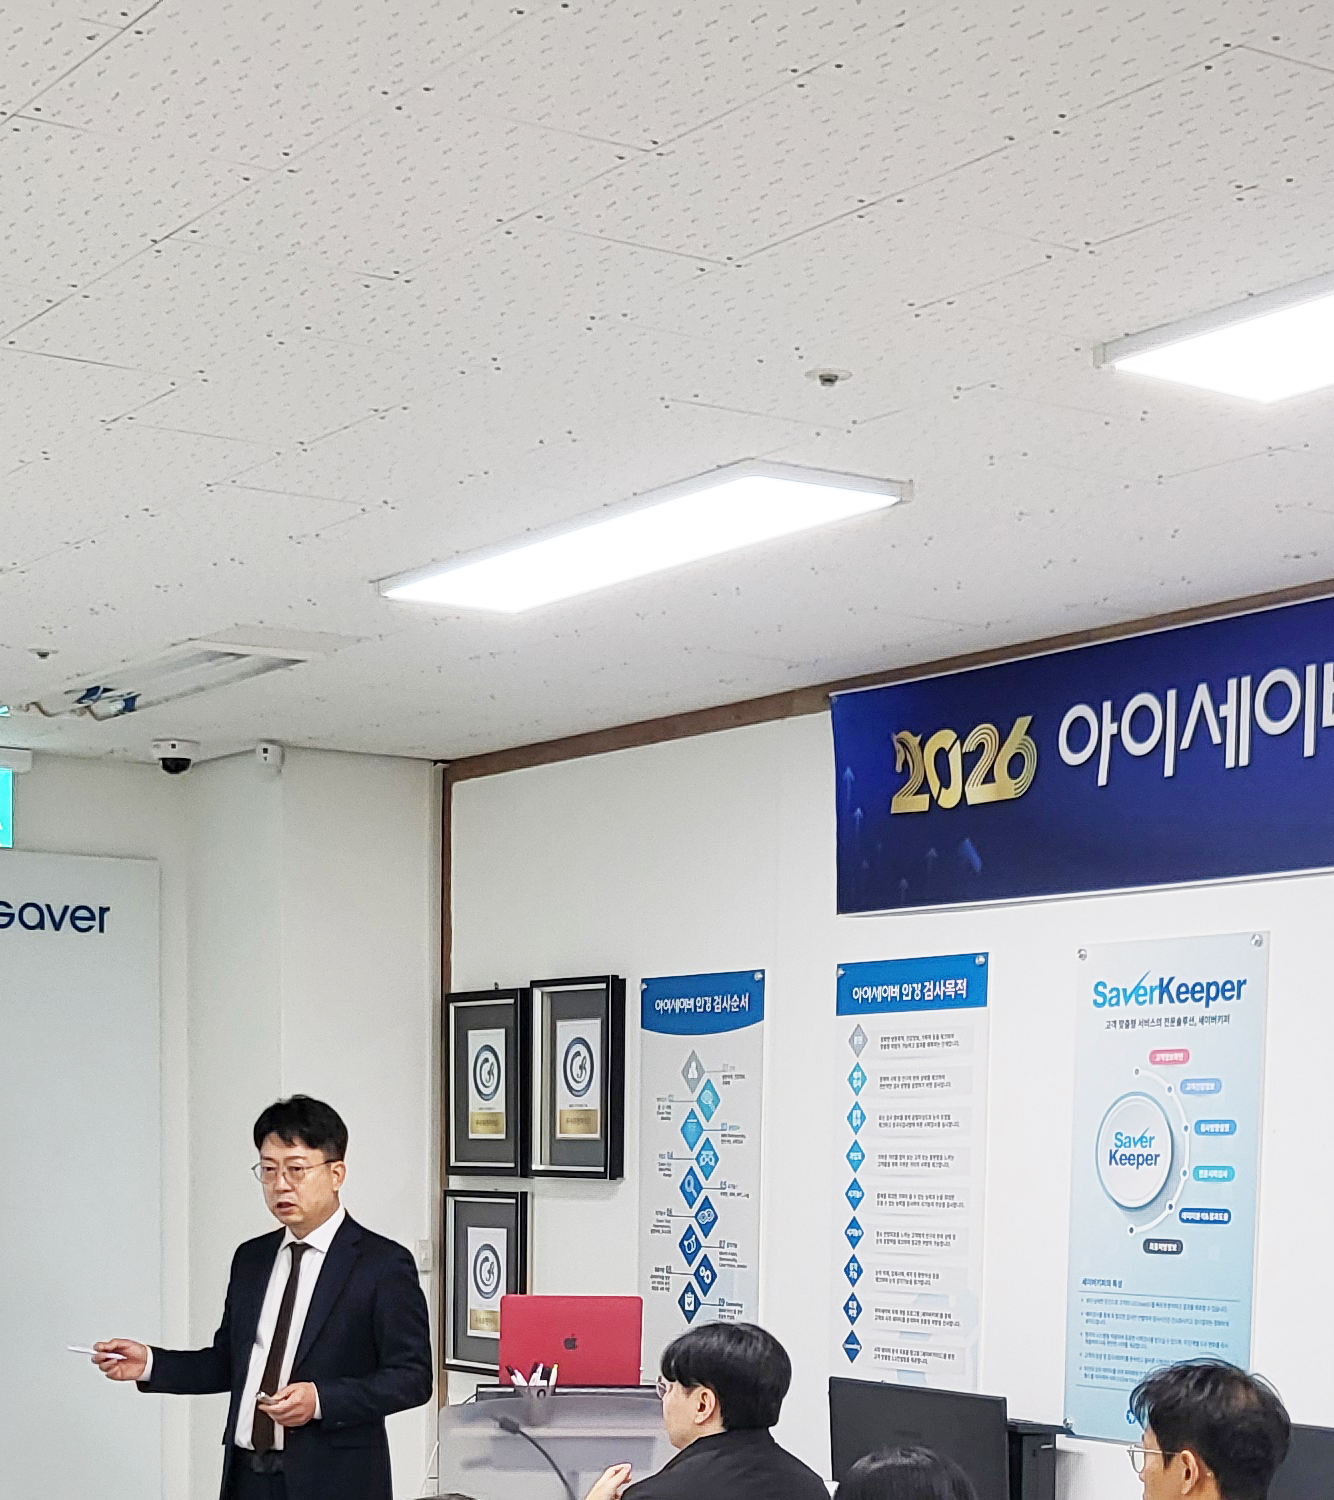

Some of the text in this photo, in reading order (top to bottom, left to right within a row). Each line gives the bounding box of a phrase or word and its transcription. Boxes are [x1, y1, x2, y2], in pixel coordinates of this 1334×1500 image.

[891, 714, 1038, 814] 2026
[852, 985, 899, 1004] 아이세이버
[923, 977, 967, 1001] 검사목적
[1092, 969, 1248, 1009] SaverKeeper
[713, 992, 750, 1013] 검사순서
[1113, 1126, 1156, 1150] Saver
[1108, 1149, 1161, 1170] Keeper
